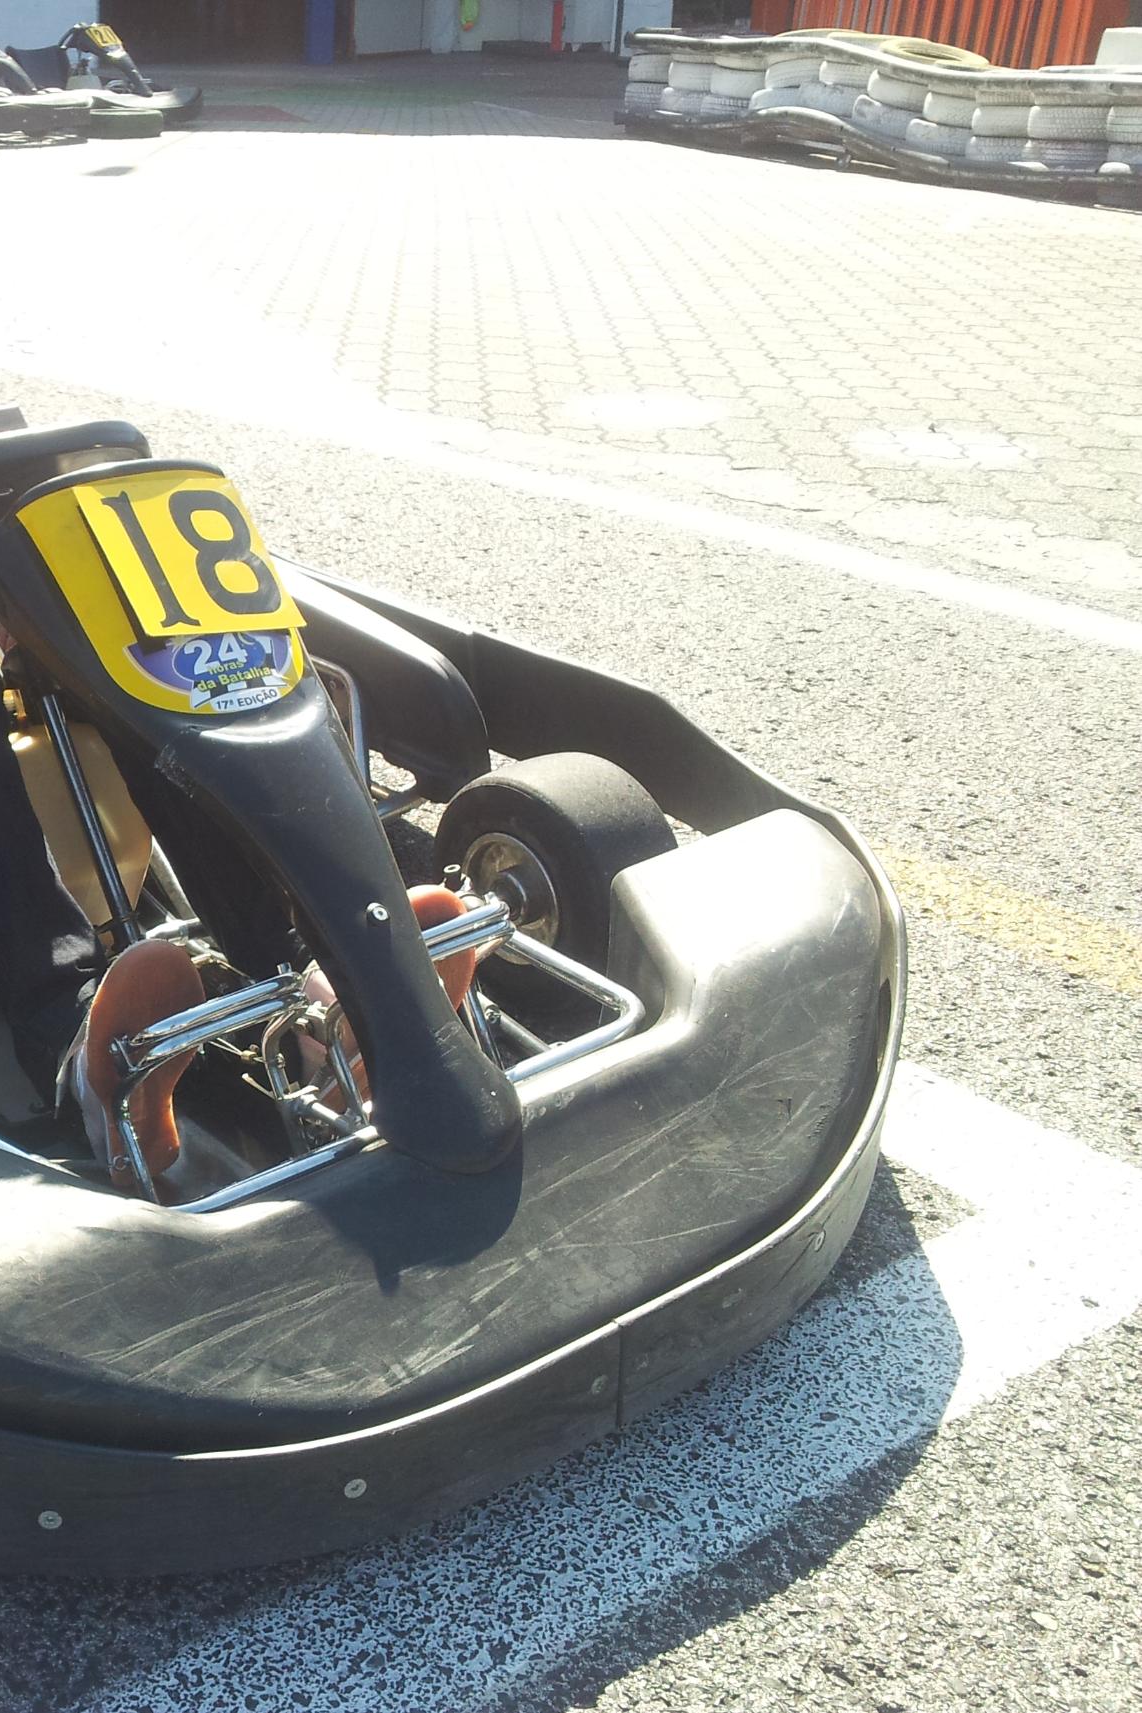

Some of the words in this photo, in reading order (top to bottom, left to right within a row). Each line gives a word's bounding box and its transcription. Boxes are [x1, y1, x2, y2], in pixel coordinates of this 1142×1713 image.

[101, 490, 282, 627] 18
[184, 633, 248, 675] 24
[197, 679, 217, 693] da
[218, 666, 271, 685] Batalha
[238, 689, 278, 707] EDIÇÃO
